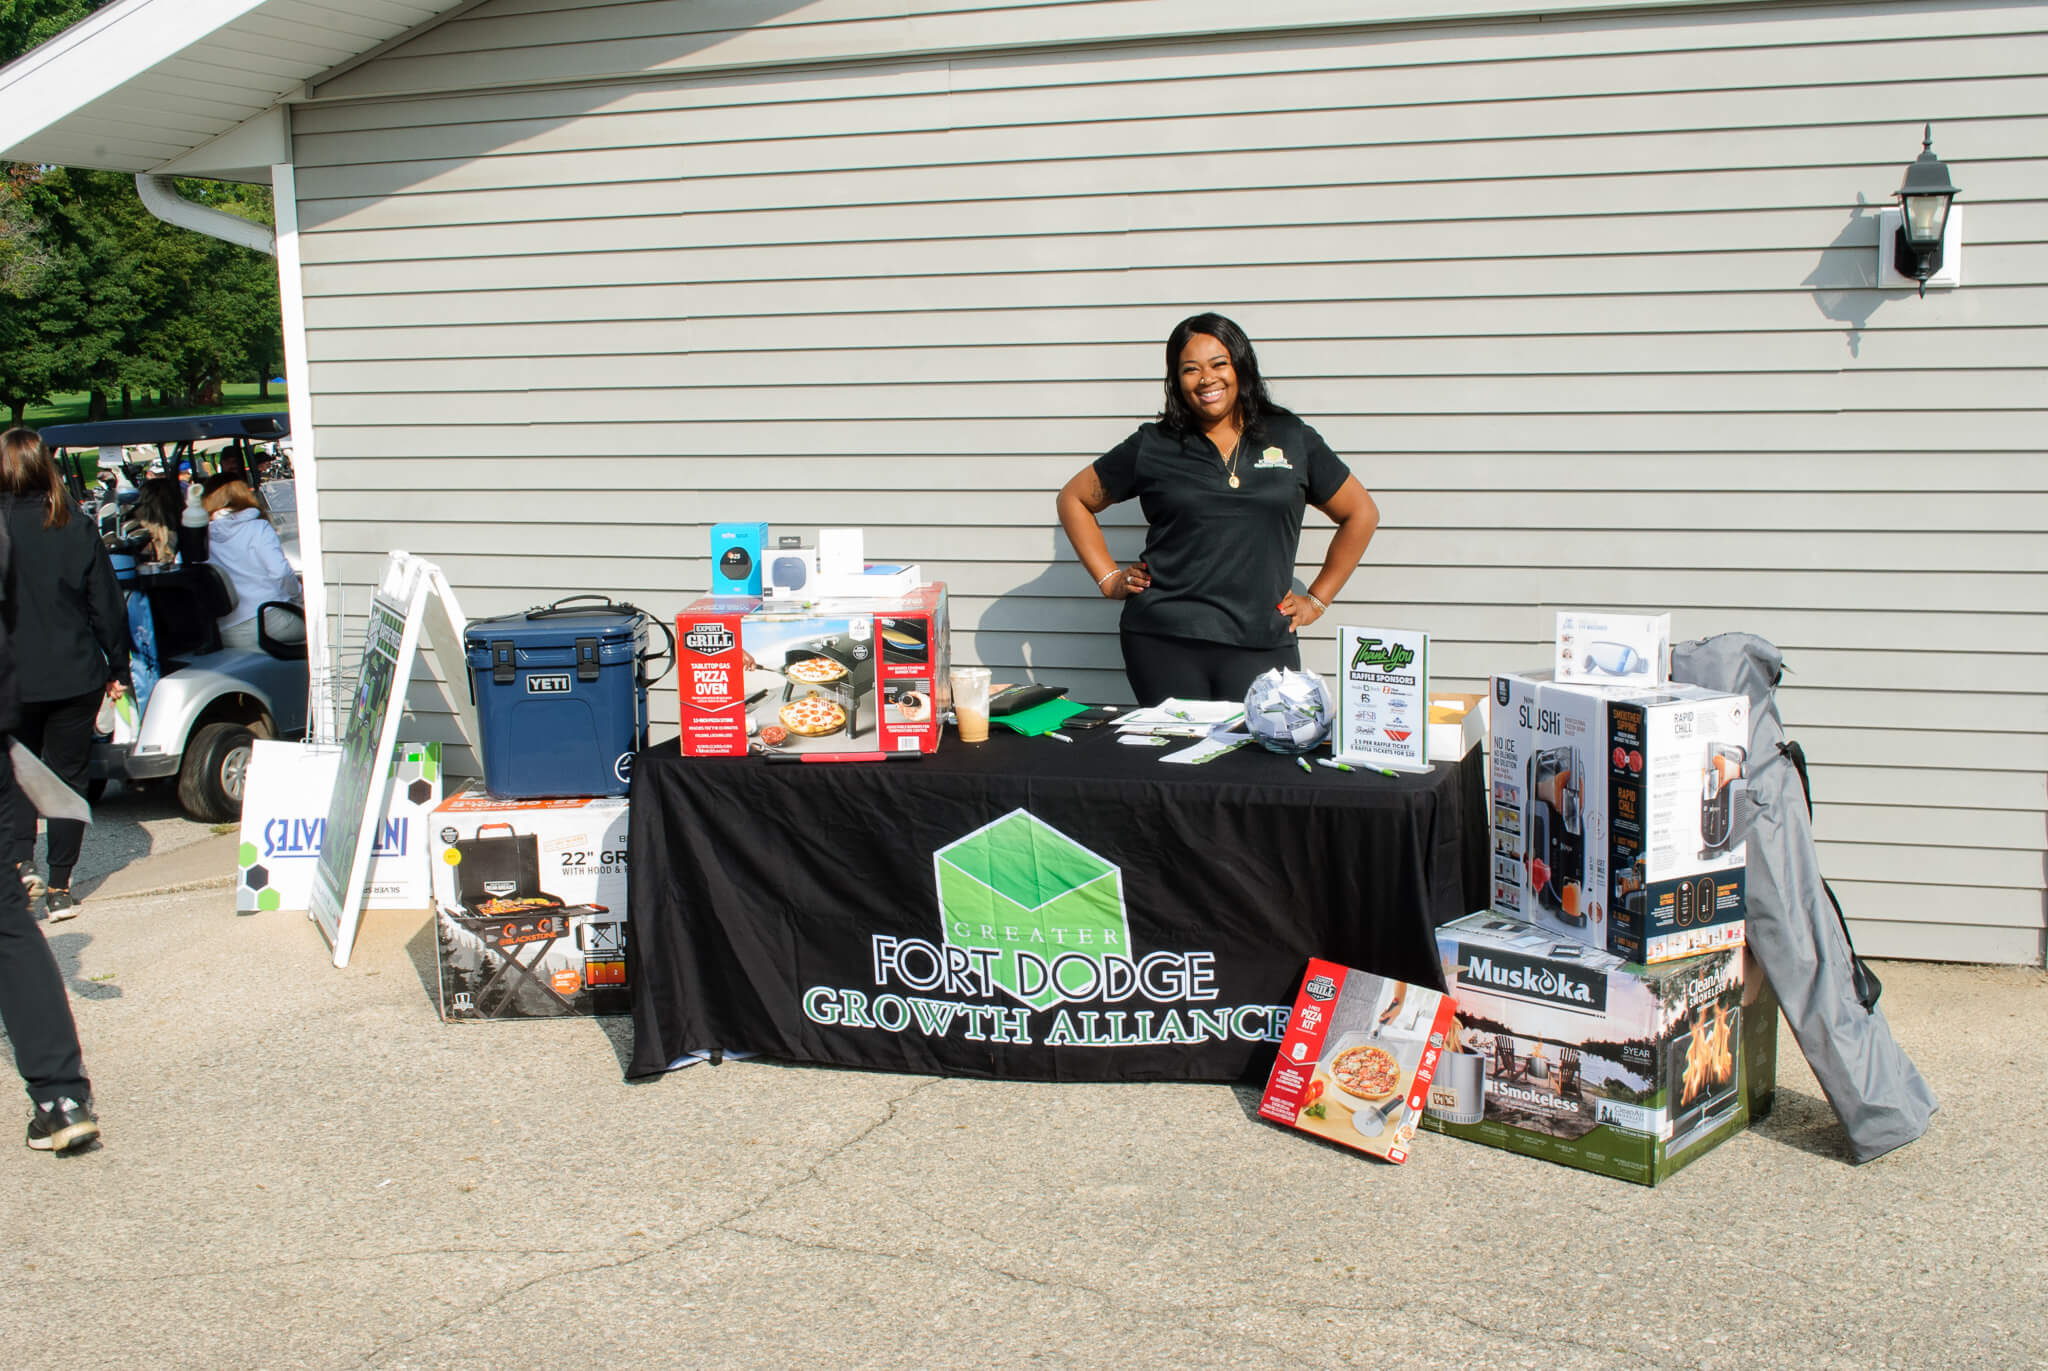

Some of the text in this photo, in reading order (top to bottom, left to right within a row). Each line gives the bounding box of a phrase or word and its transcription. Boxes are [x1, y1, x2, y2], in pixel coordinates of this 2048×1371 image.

[686, 634, 732, 648] GRILL
[1352, 636, 1414, 673] Thank You
[530, 677, 568, 690] YETI
[693, 670, 729, 682] PIZZA
[1352, 671, 1413, 685] RAFFLE SPONSORS
[695, 683, 728, 695] OVEN
[1494, 736, 1515, 752] NO ICE
[561, 851, 628, 866] 22" GR
[562, 866, 585, 876] WITH
[588, 866, 612, 874] HOOD
[374, 886, 400, 894] SILVER
[954, 921, 1120, 945] GREATER
[872, 935, 1220, 1003] FORT DODGE
[1468, 955, 1591, 1003] Muskoka
[1307, 982, 1334, 998] GRILL
[803, 985, 1293, 1047] GROWTH ALLIANCE
[1300, 1008, 1322, 1023] PIZZA
[1302, 1019, 1316, 1030] KIT
[1500, 1083, 1579, 1113] Smokeless
